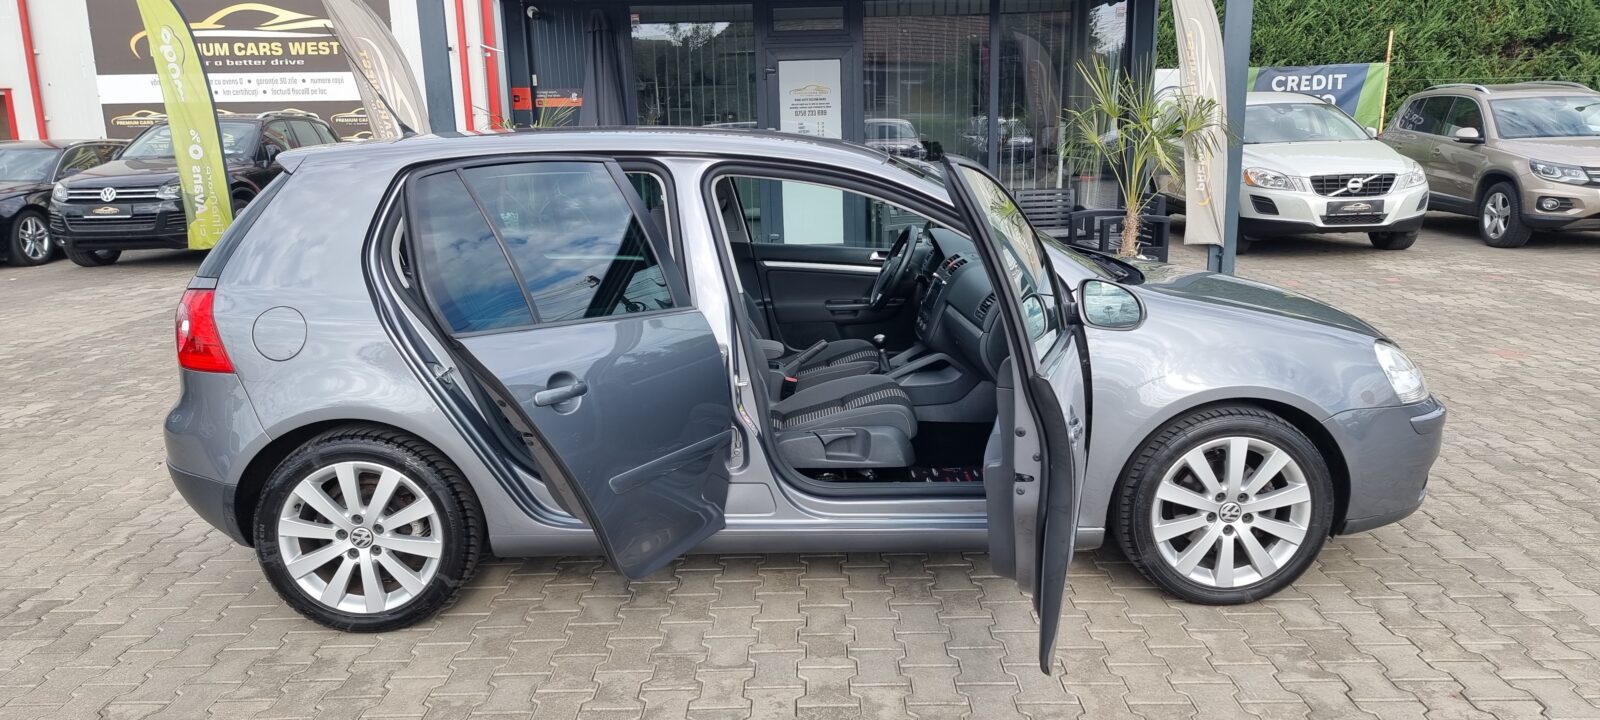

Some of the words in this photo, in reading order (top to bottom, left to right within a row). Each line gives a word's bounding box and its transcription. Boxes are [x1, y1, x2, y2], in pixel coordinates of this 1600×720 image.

[233, 42, 283, 56] CARS
[288, 41, 340, 56] WEST
[270, 58, 305, 66] drive
[1271, 74, 1348, 92] CREDIT
